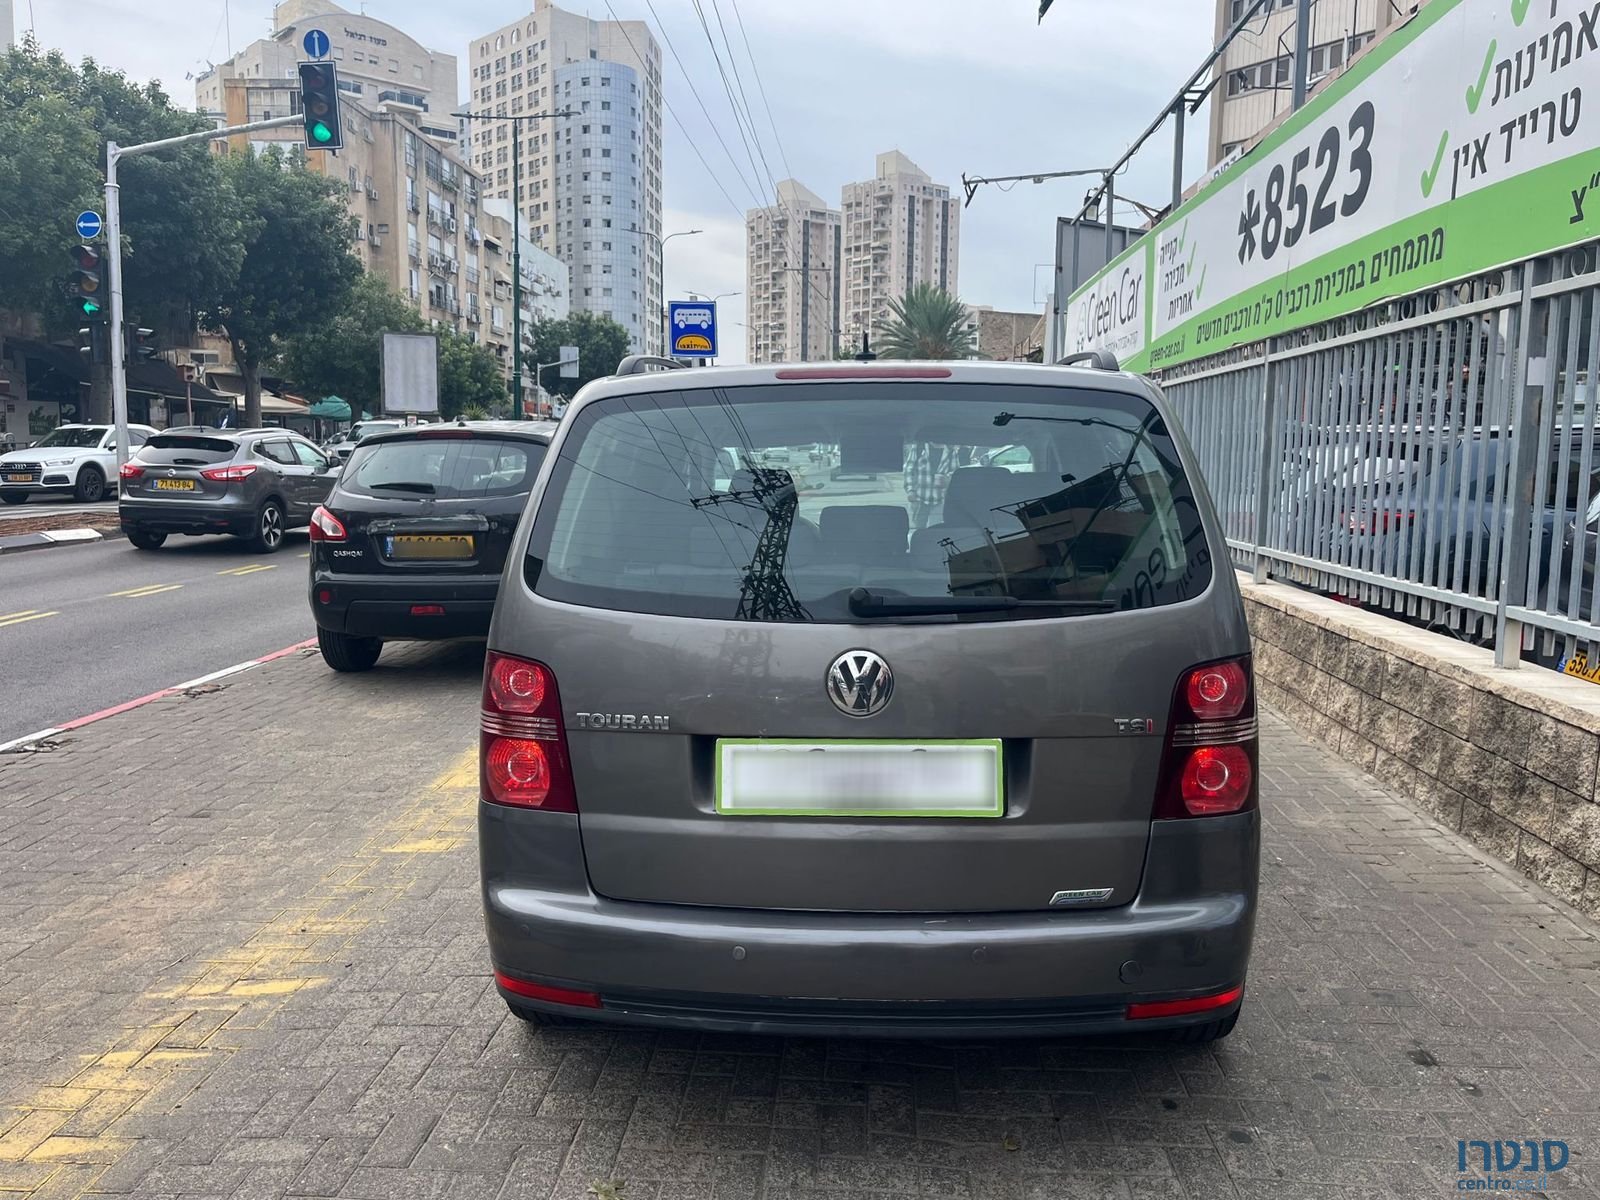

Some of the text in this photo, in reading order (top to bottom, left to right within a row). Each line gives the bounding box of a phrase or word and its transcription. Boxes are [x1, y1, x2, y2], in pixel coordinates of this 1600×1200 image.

[1451, 87, 1582, 200] טרייד אין
[1370, 227, 1444, 284] מתמחים
[1164, 262, 1185, 292] מכירה
[1312, 259, 1366, 306] במכירת
[1120, 267, 1142, 325] Car
[1168, 289, 1194, 320] אחריות
[1285, 283, 1310, 314] רכבי
[1196, 317, 1222, 345] חדשים
[1223, 305, 1252, 335] ורכבים
[577, 712, 670, 730] TOURAN
[1114, 718, 1153, 734] TSI
